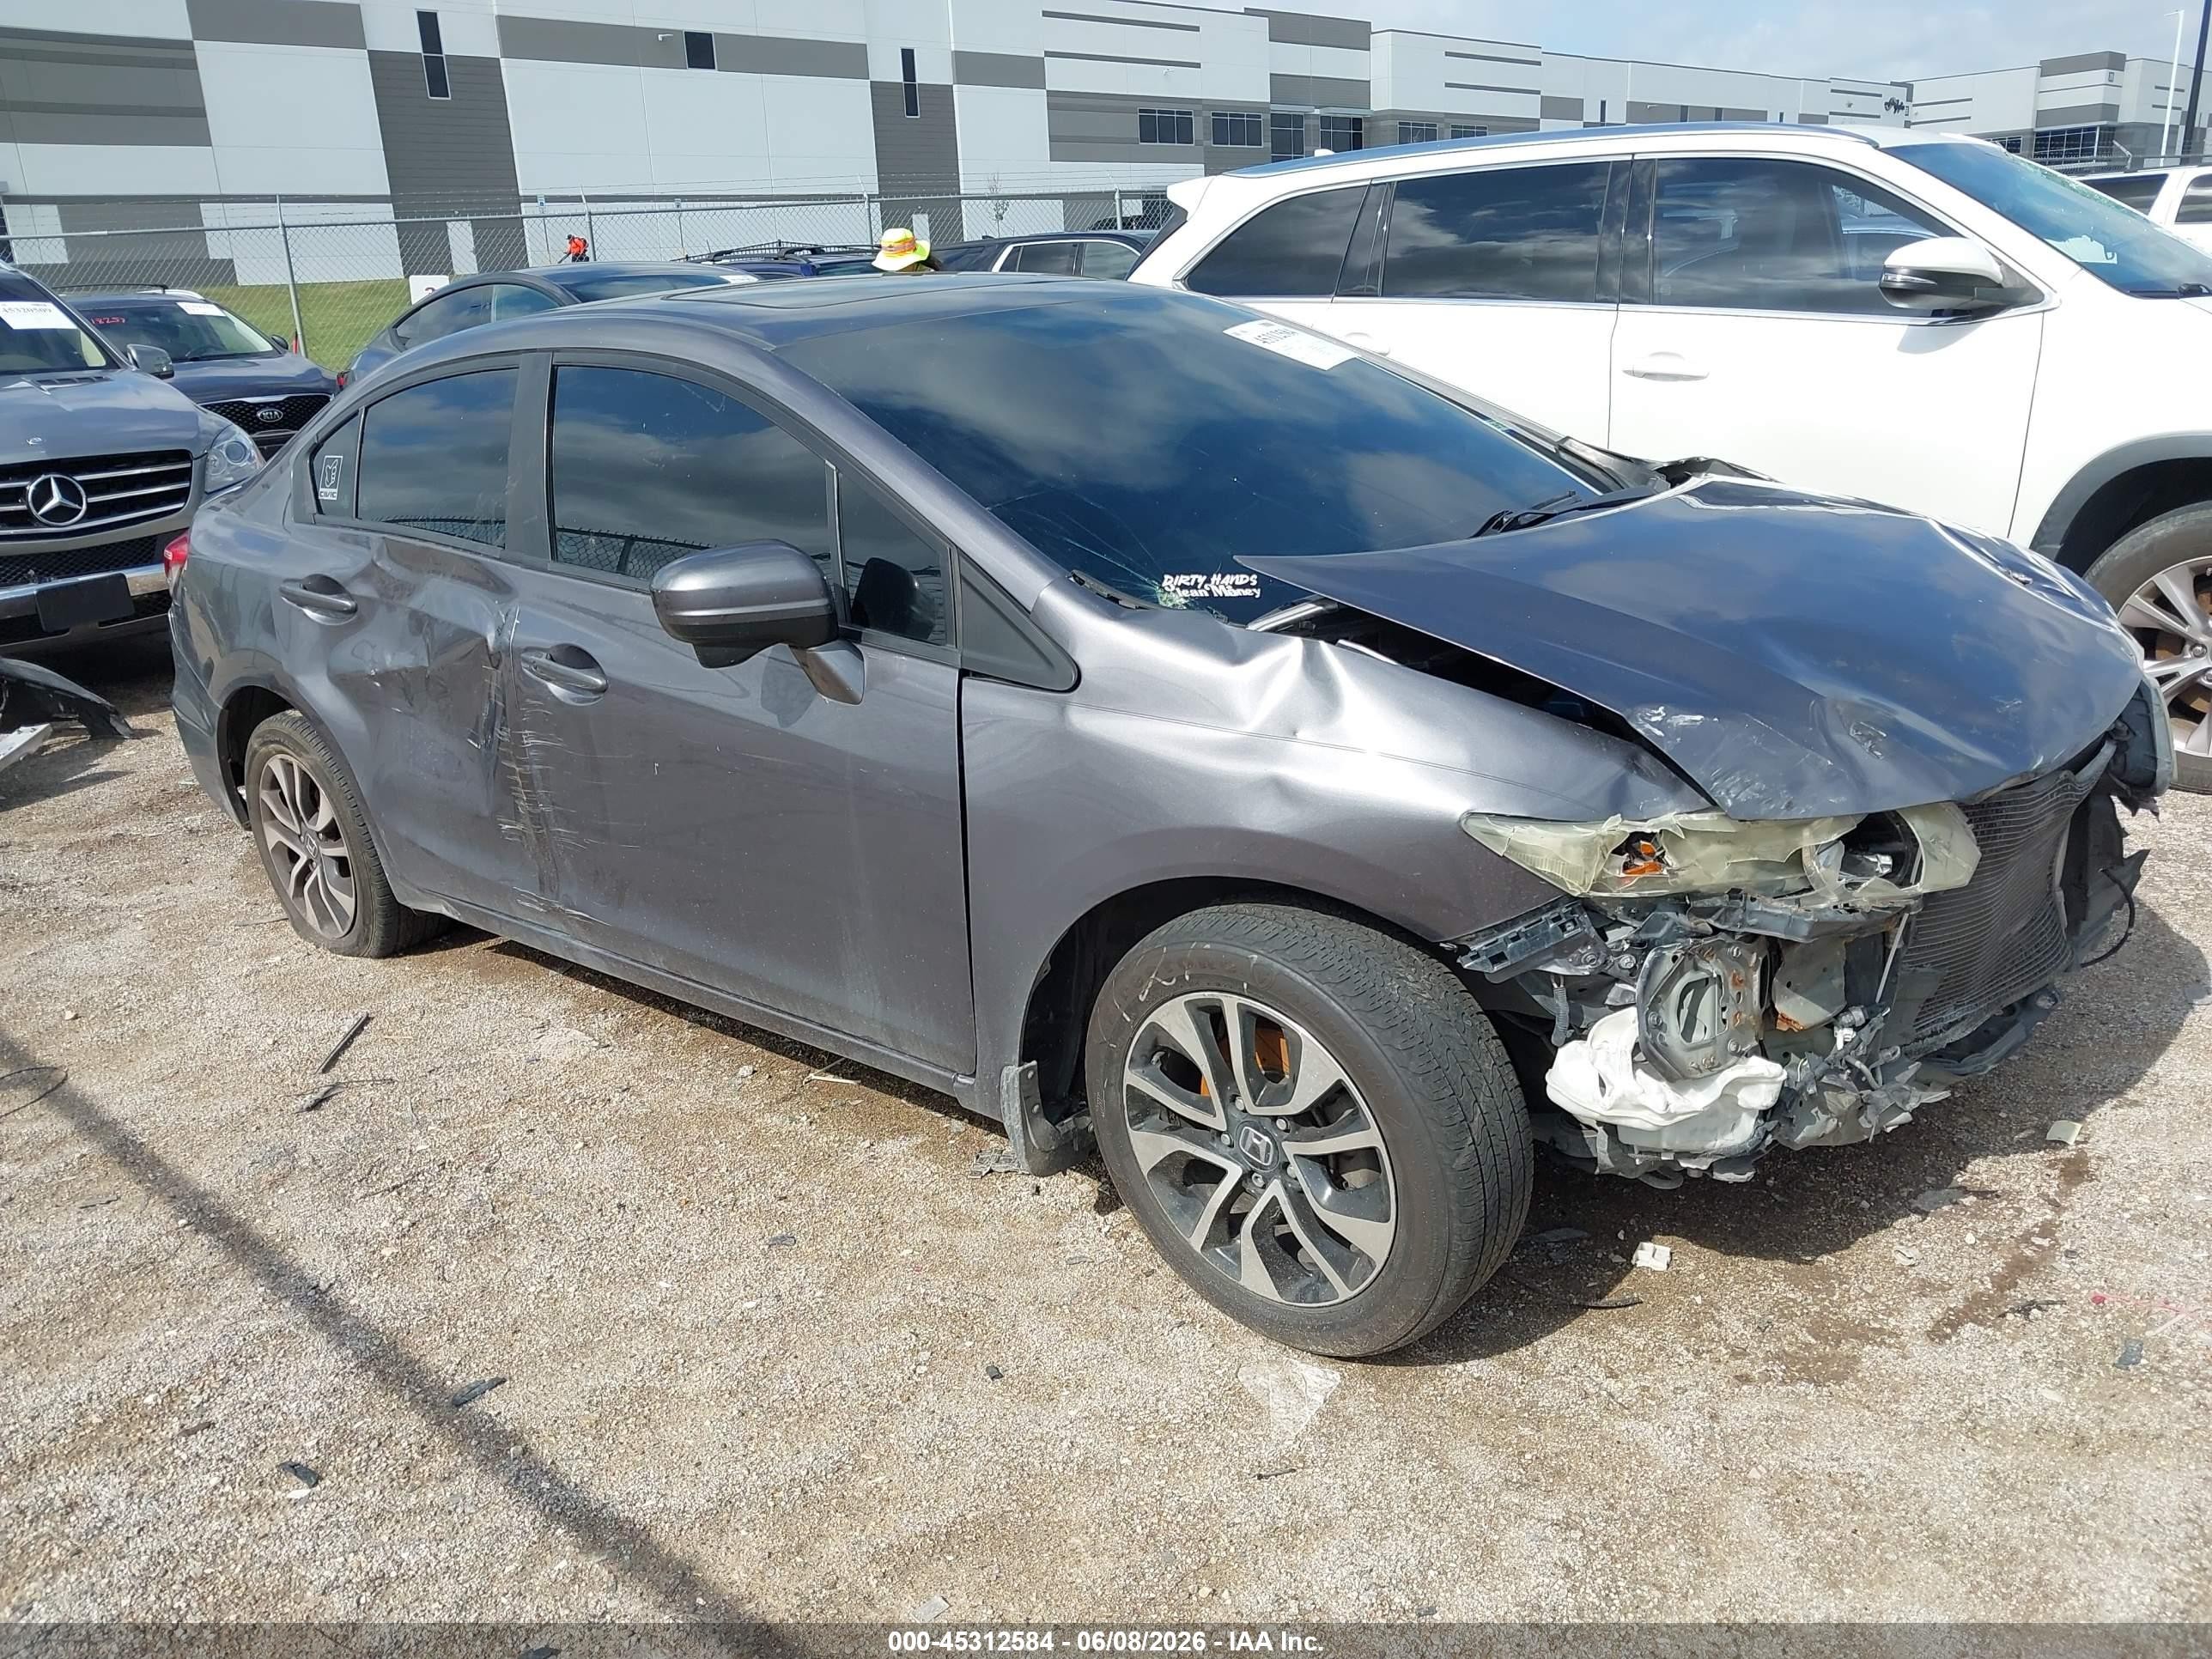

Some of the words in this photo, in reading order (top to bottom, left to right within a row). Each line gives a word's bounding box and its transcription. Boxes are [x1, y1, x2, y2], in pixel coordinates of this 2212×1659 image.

[1162, 574, 1207, 588] DIRTY
[1210, 574, 1258, 586] HANDS
[1206, 583, 1261, 599] Money
